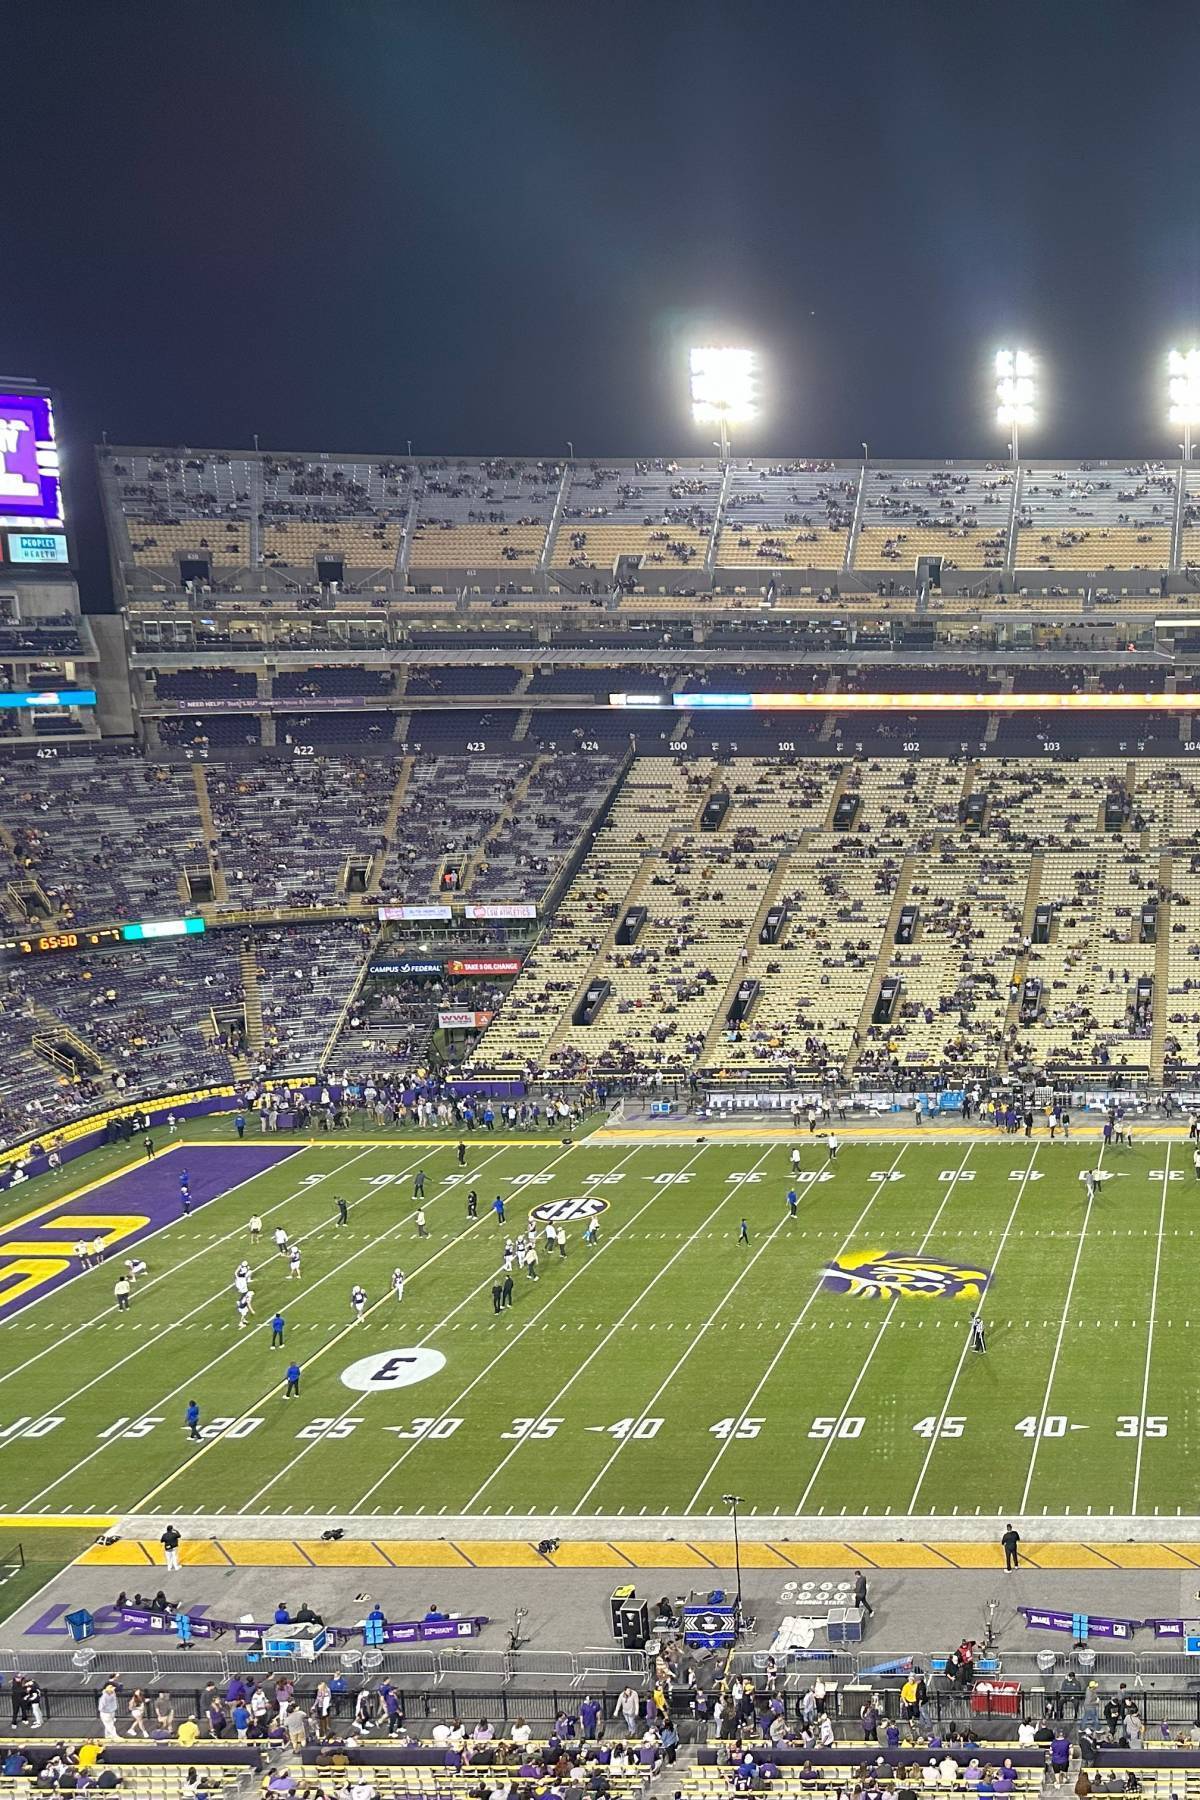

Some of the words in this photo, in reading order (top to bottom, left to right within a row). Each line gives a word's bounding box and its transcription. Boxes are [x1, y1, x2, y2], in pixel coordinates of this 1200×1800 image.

[23, 551, 57, 559] HEALTH
[293, 745, 314, 755] 422
[466, 742, 486, 752] 423
[580, 741, 599, 750] 424
[669, 741, 688, 751] 100
[778, 741, 796, 751] 101
[902, 741, 920, 751] 102
[1043, 741, 1061, 751] 103
[37, 749, 57, 759] 421
[39, 935, 78, 950] 65:30
[370, 966, 399, 974] CAMPUS
[411, 965, 441, 973] FEDERAL
[464, 963, 478, 971] TAKE
[298, 1174, 327, 1185] 5
[439, 1174, 482, 1184] 15
[511, 1174, 557, 1184] 20
[581, 1173, 628, 1184] 25
[653, 1173, 697, 1183] 30
[724, 1173, 769, 1183] 35
[798, 1172, 837, 1183] 40
[867, 1171, 907, 1182] 45
[937, 1171, 978, 1182] 50
[1007, 1171, 1046, 1182] 45
[1148, 1170, 1185, 1181] 35
[535, 1198, 604, 1221] SEC
[370, 1355, 419, 1381] 3
[1, 1416, 66, 1438] 10
[97, 1417, 165, 1439] 15
[200, 1417, 265, 1439] 20
[295, 1417, 364, 1439] 25
[398, 1417, 461, 1439] 30
[501, 1417, 565, 1439] 35
[606, 1417, 665, 1439] 40
[708, 1417, 766, 1439] 45
[808, 1417, 866, 1439] 50
[913, 1417, 968, 1439] 45
[1014, 1416, 1069, 1438] 40
[1115, 1416, 1169, 1438] 35
